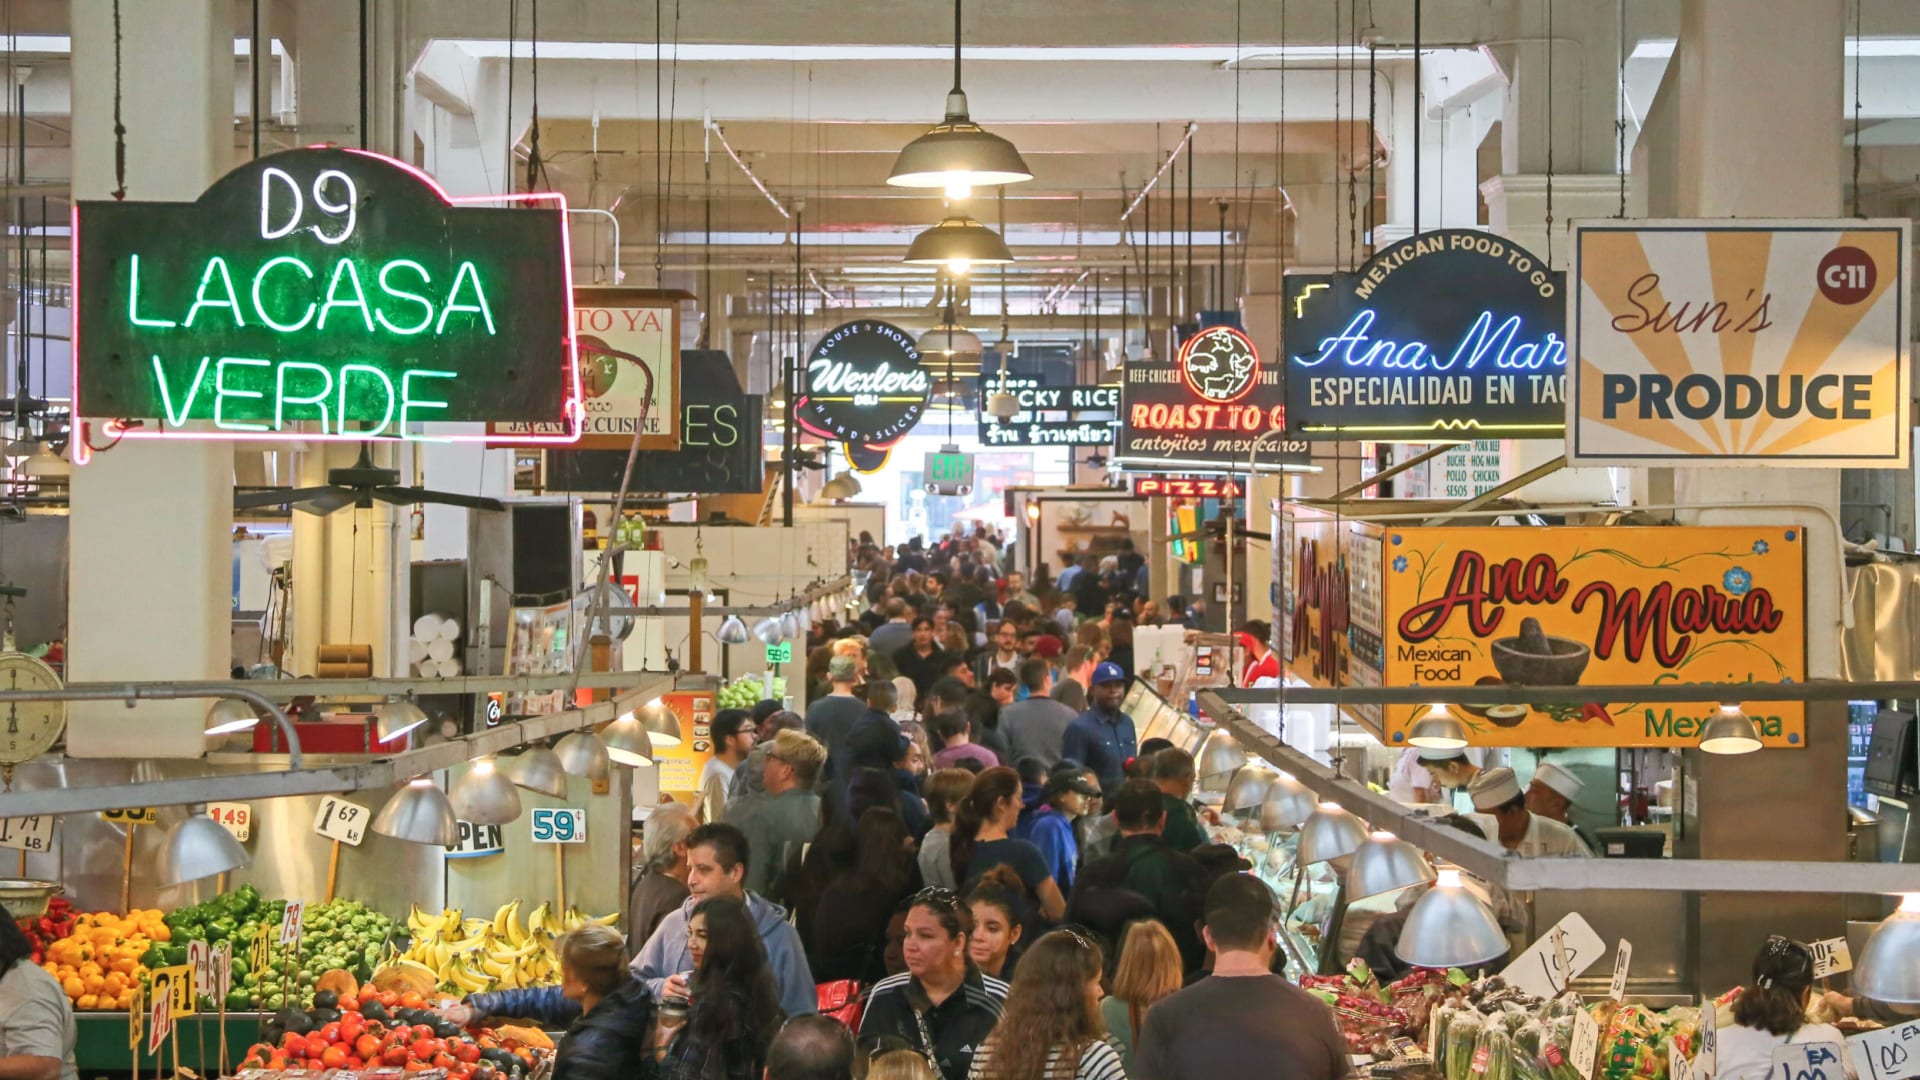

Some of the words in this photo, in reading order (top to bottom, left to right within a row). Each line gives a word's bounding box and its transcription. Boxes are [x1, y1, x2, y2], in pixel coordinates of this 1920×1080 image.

[262, 167, 356, 244] D9
[1355, 235, 1444, 299] MEXICAN
[1451, 235, 1503, 257] FOOD
[1507, 250, 1531, 272] TO
[1530, 271, 1555, 298] GO
[1611, 273, 1773, 334] Sun's
[621, 309, 662, 332] YA
[819, 324, 859, 356] HOUSE
[876, 325, 918, 360] SMOKED
[1294, 309, 1428, 370] Ana
[152, 355, 458, 443] VERDE
[1072, 388, 1120, 407] RICE
[1311, 375, 1472, 406] ESPECIALIDAD
[1486, 375, 1515, 404] EN
[1602, 374, 1874, 420] PRODUCE
[816, 404, 859, 440] HAND
[876, 404, 919, 440] SLICED
[1131, 403, 1221, 431] ROAST
[1227, 406, 1261, 432] TO
[1131, 433, 1207, 457] antojitos
[1213, 435, 1308, 453] mexicanos
[932, 453, 966, 481] EXIT
[1446, 470, 1467, 482] POLLO
[1137, 481, 1240, 495] PIZZA
[1446, 484, 1468, 497] SESOS
[1398, 550, 1568, 644] Ana
[1571, 580, 1784, 669] Maria
[1397, 645, 1472, 663] Mexican
[1414, 665, 1462, 682] Food
[25, 836, 42, 849] LB
